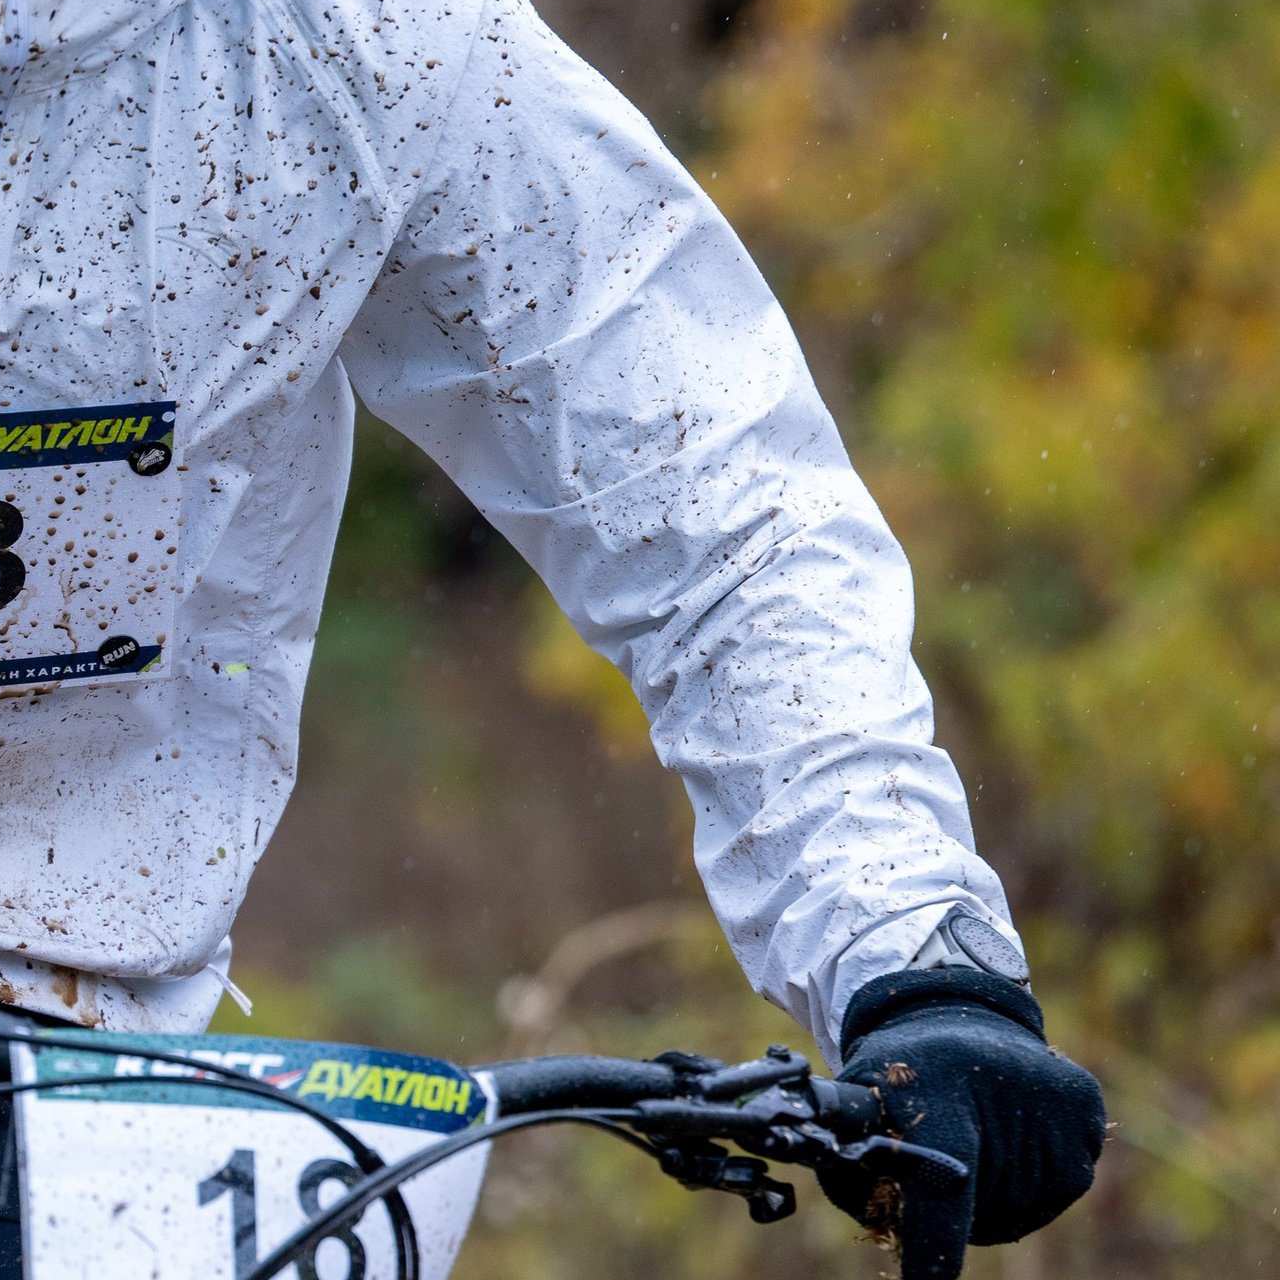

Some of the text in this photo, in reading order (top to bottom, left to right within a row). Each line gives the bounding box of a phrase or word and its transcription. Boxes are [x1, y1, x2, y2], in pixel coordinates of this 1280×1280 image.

[102, 640, 136, 665] RUN
[25, 661, 108, 679] ХАРАКТЕ
[298, 1059, 472, 1115] ДУАТЛОН
